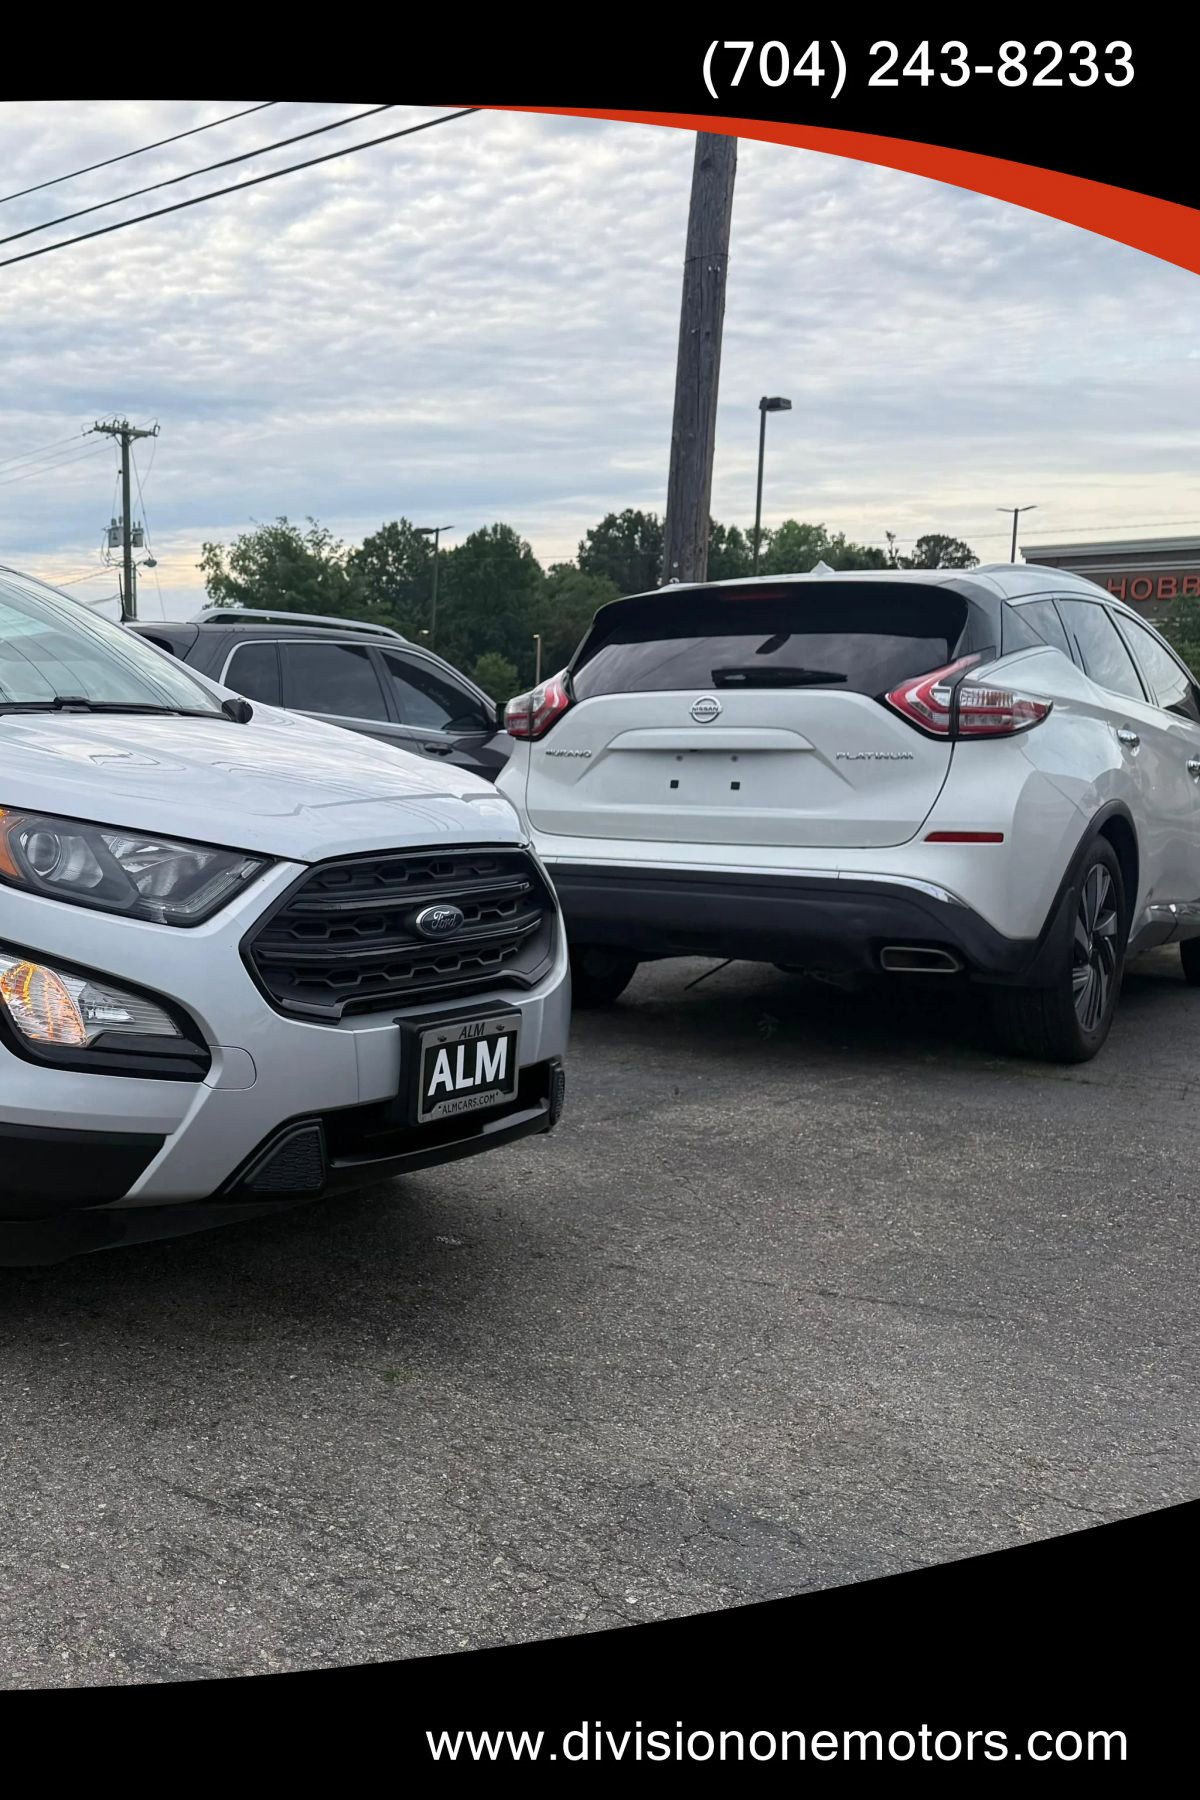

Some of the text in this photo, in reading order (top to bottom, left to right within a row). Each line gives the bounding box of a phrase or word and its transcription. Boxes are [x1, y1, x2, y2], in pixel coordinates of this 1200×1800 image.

[836, 751, 914, 760] PLATINUM
[431, 910, 456, 929] Ford
[458, 1022, 485, 1039] ALM
[427, 1036, 508, 1096] ALM
[441, 1094, 495, 1114] ALMCARS.COM
